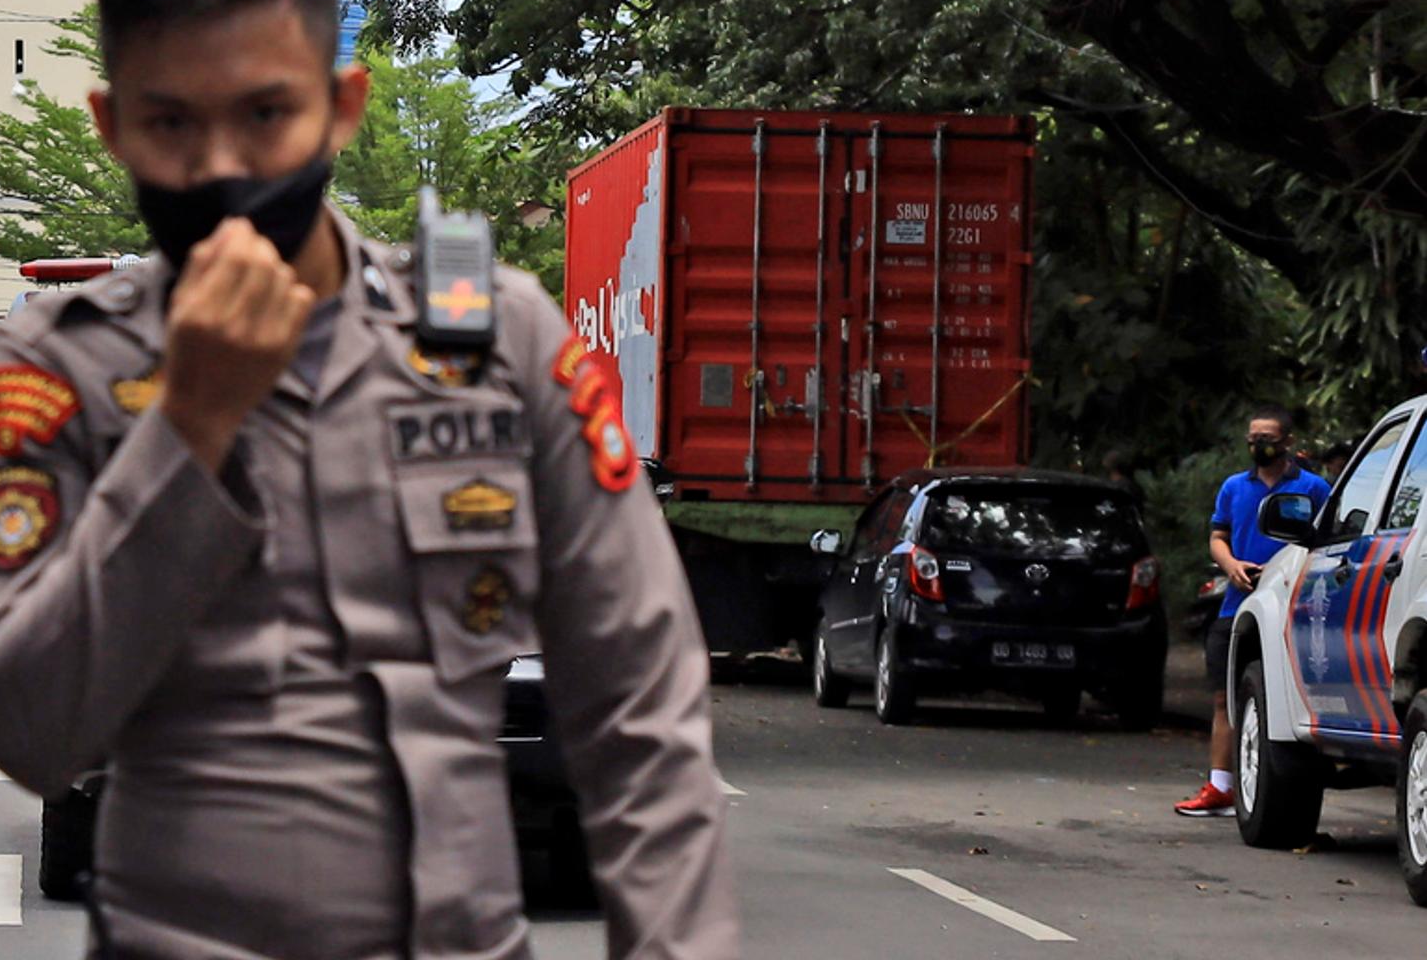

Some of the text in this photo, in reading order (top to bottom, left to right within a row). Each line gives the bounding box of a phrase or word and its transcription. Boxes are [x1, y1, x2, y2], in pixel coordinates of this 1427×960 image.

[896, 203, 1020, 222] SBNU 216065 4
